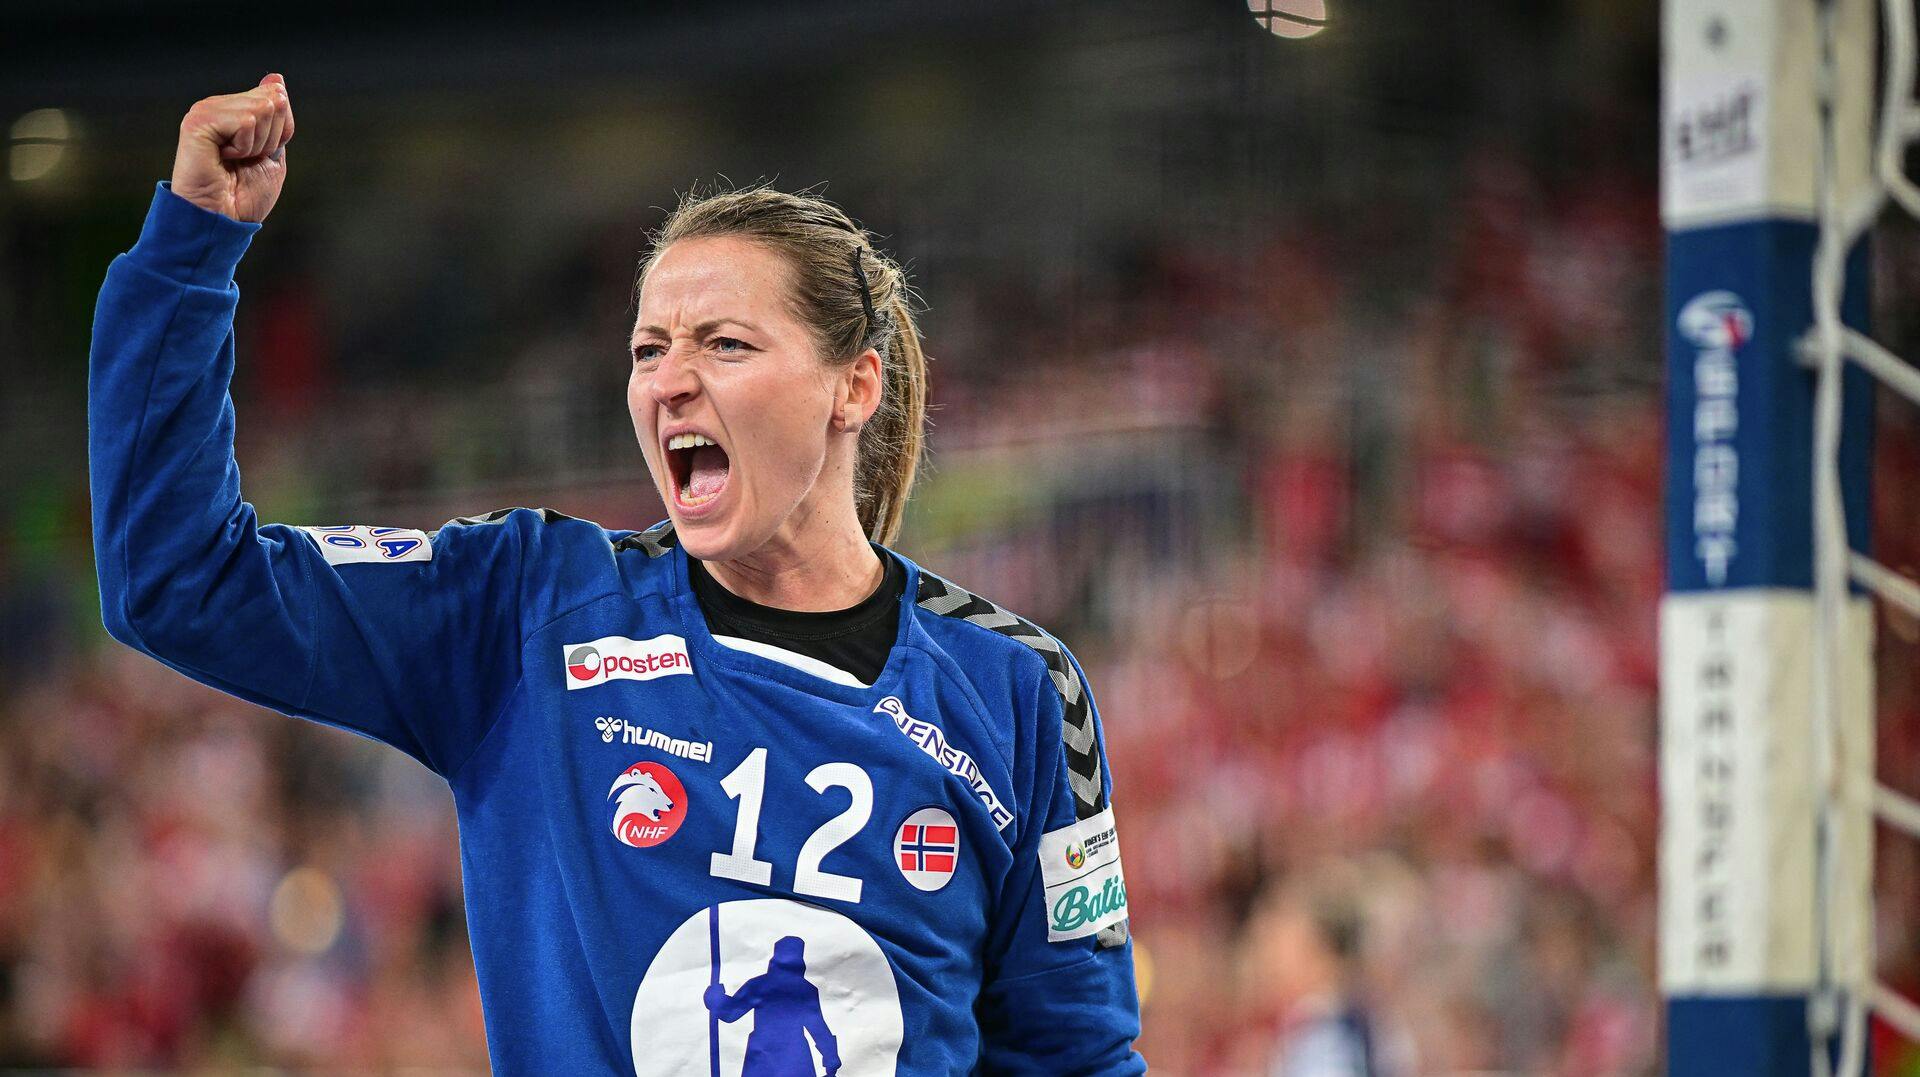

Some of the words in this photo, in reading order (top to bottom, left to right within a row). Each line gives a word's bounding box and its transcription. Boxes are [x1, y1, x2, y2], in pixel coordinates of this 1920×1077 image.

[603, 652, 690, 679] posten
[622, 719, 714, 764] hummel
[629, 825, 669, 839] NHF
[709, 747, 874, 904] 12
